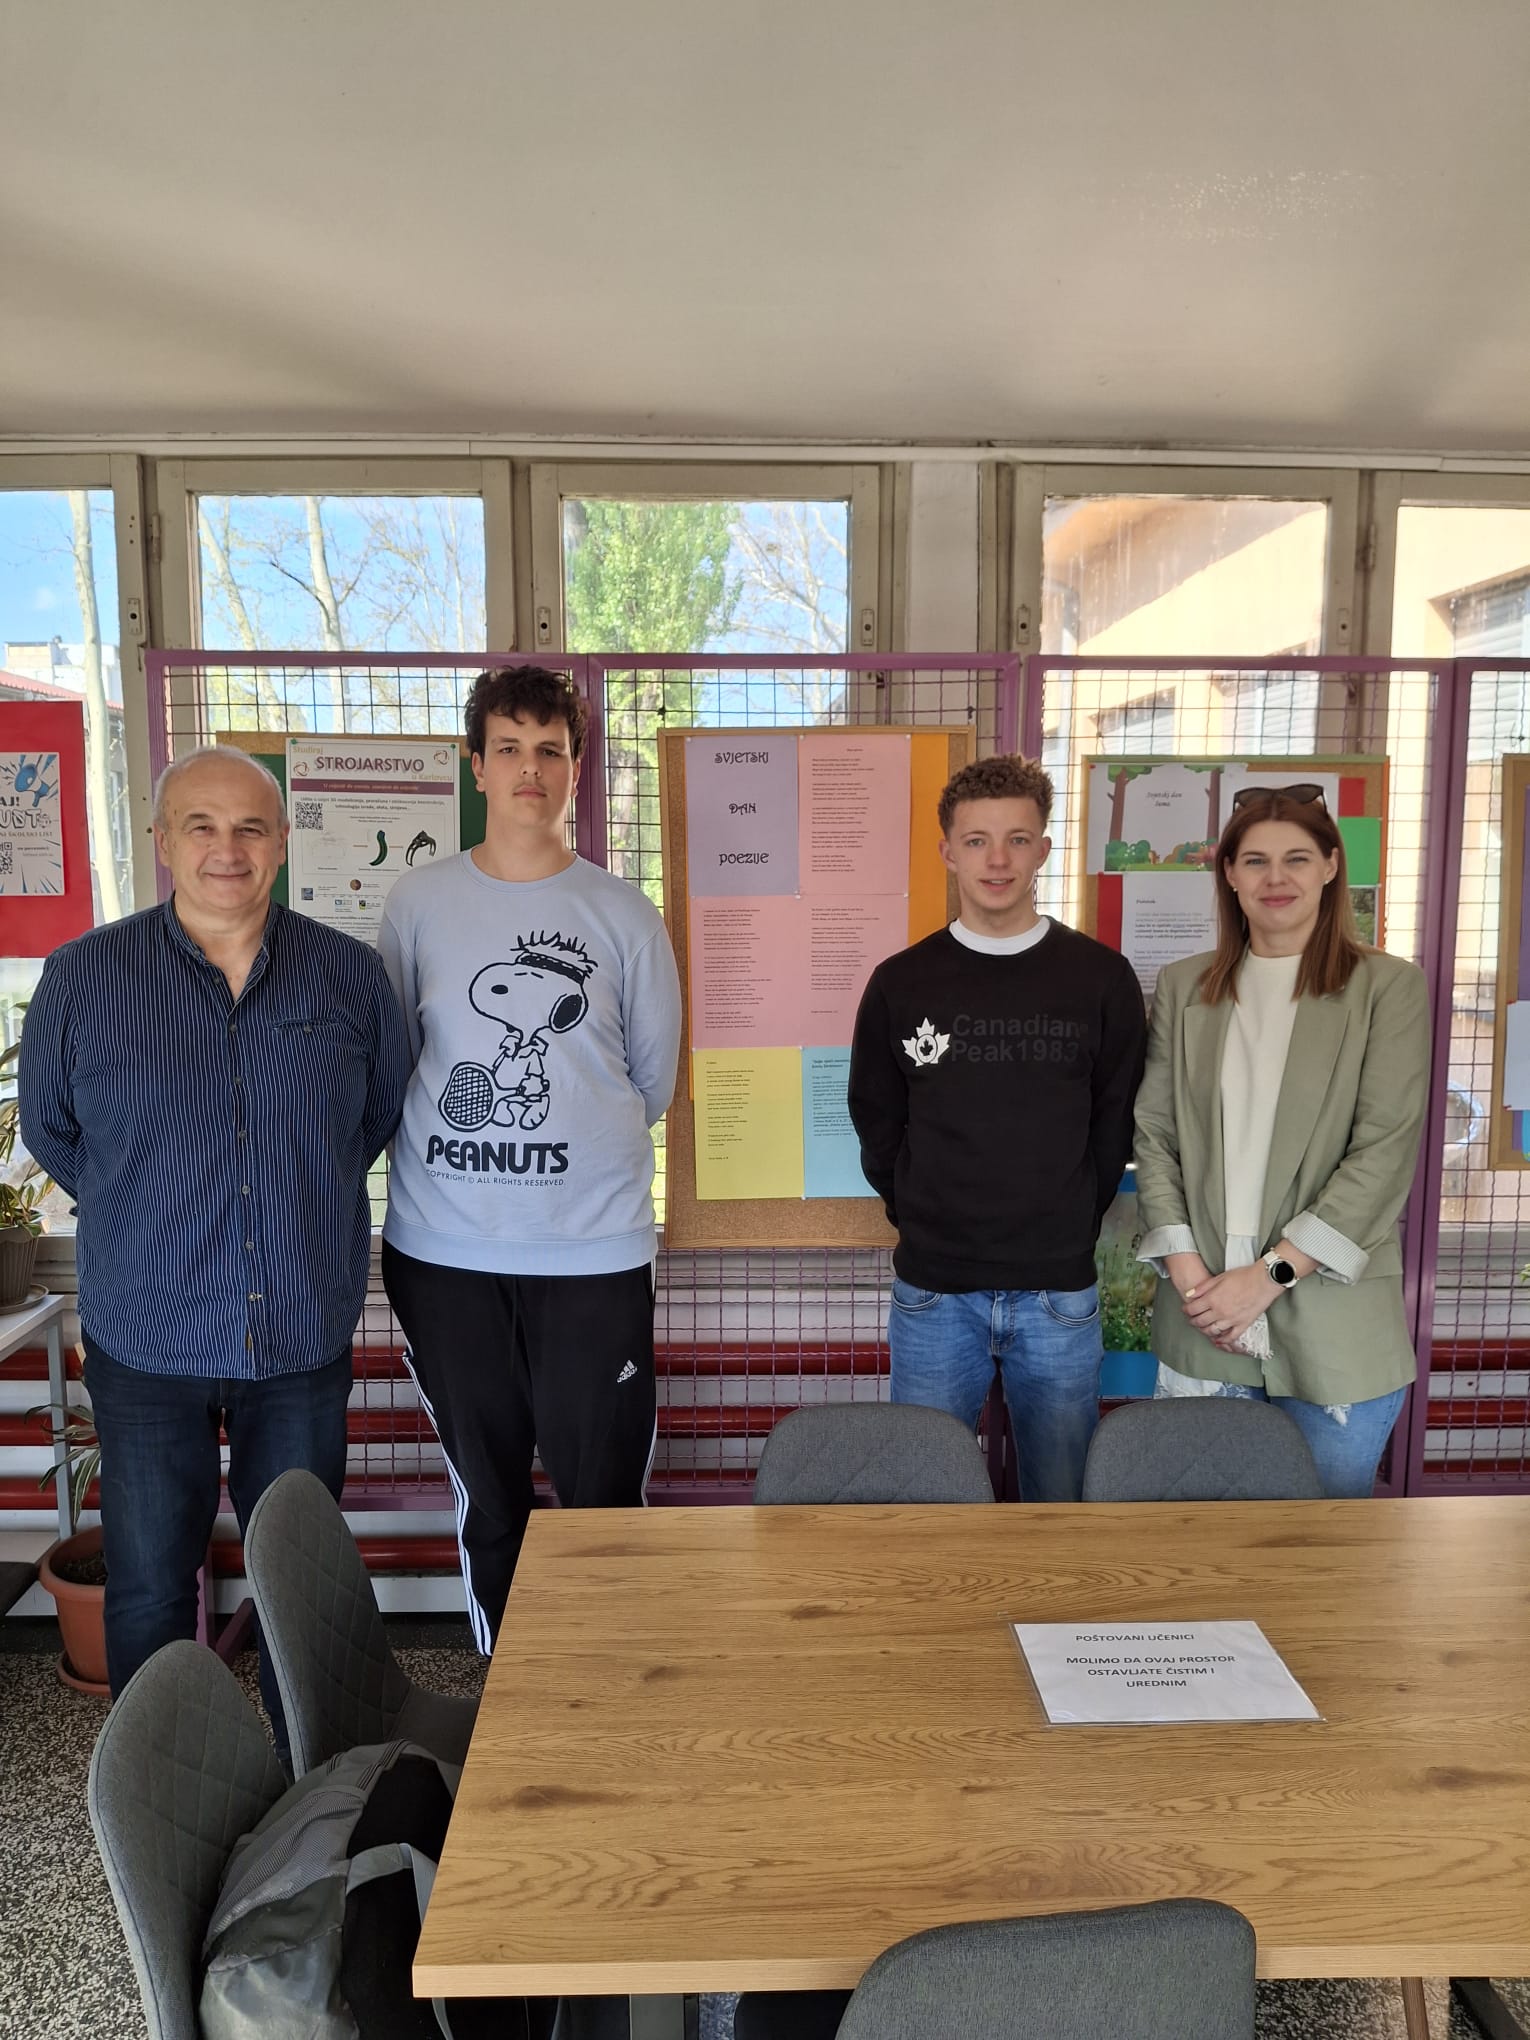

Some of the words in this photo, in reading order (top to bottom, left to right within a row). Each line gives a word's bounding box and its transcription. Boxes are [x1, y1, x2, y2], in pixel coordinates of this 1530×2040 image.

[316, 756, 425, 773] STROJARSTVO
[729, 803, 756, 815] DAN
[952, 1014, 1081, 1038] Canadian
[426, 1135, 569, 1174] PEANUTS
[426, 1170, 466, 1182] COPYRIGHT
[494, 1178, 522, 1186] RIGHTS
[1076, 1634, 1144, 1642] POŠTOVANI
[1148, 1633, 1195, 1641] UČENICI
[1145, 1656, 1176, 1664] OVAJ
[1179, 1655, 1236, 1663] PROSTOR
[1087, 1668, 1163, 1676] OSTAVLJATE
[1166, 1666, 1207, 1675] ČISTIM
[1126, 1680, 1187, 1688] UREDNIM
